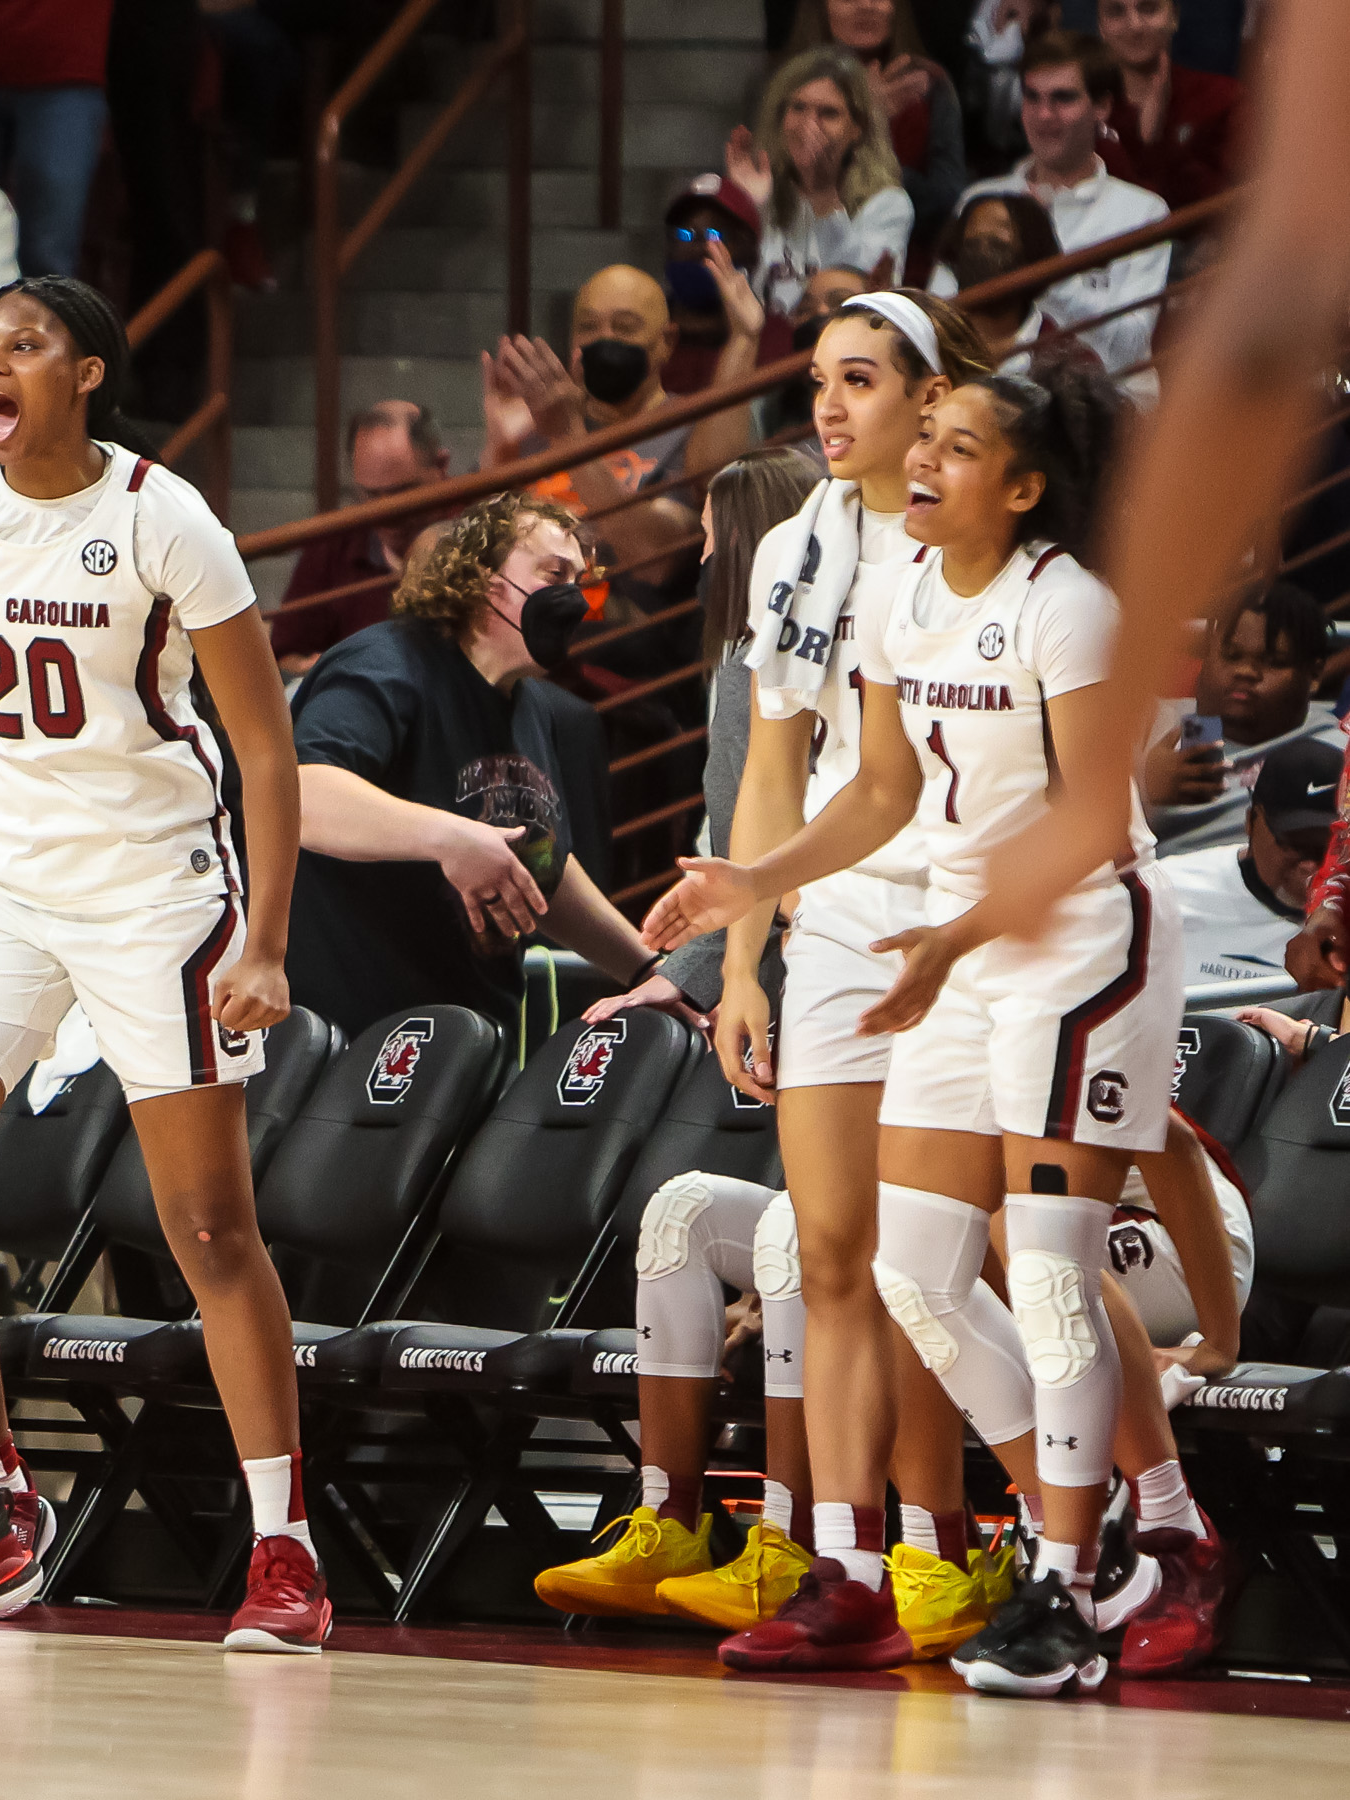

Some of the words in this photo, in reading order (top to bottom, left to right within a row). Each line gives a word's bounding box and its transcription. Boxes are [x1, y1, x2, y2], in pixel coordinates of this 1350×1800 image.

[82, 540, 117, 575] SEC
[5, 598, 111, 628] CAROLINA
[978, 622, 1005, 661] SEC
[926, 681, 1015, 711] CAROLINA
[926, 719, 962, 825] 1
[43, 1338, 128, 1362] GAMECOCKS
[400, 1347, 487, 1372] GAMECOCKS
